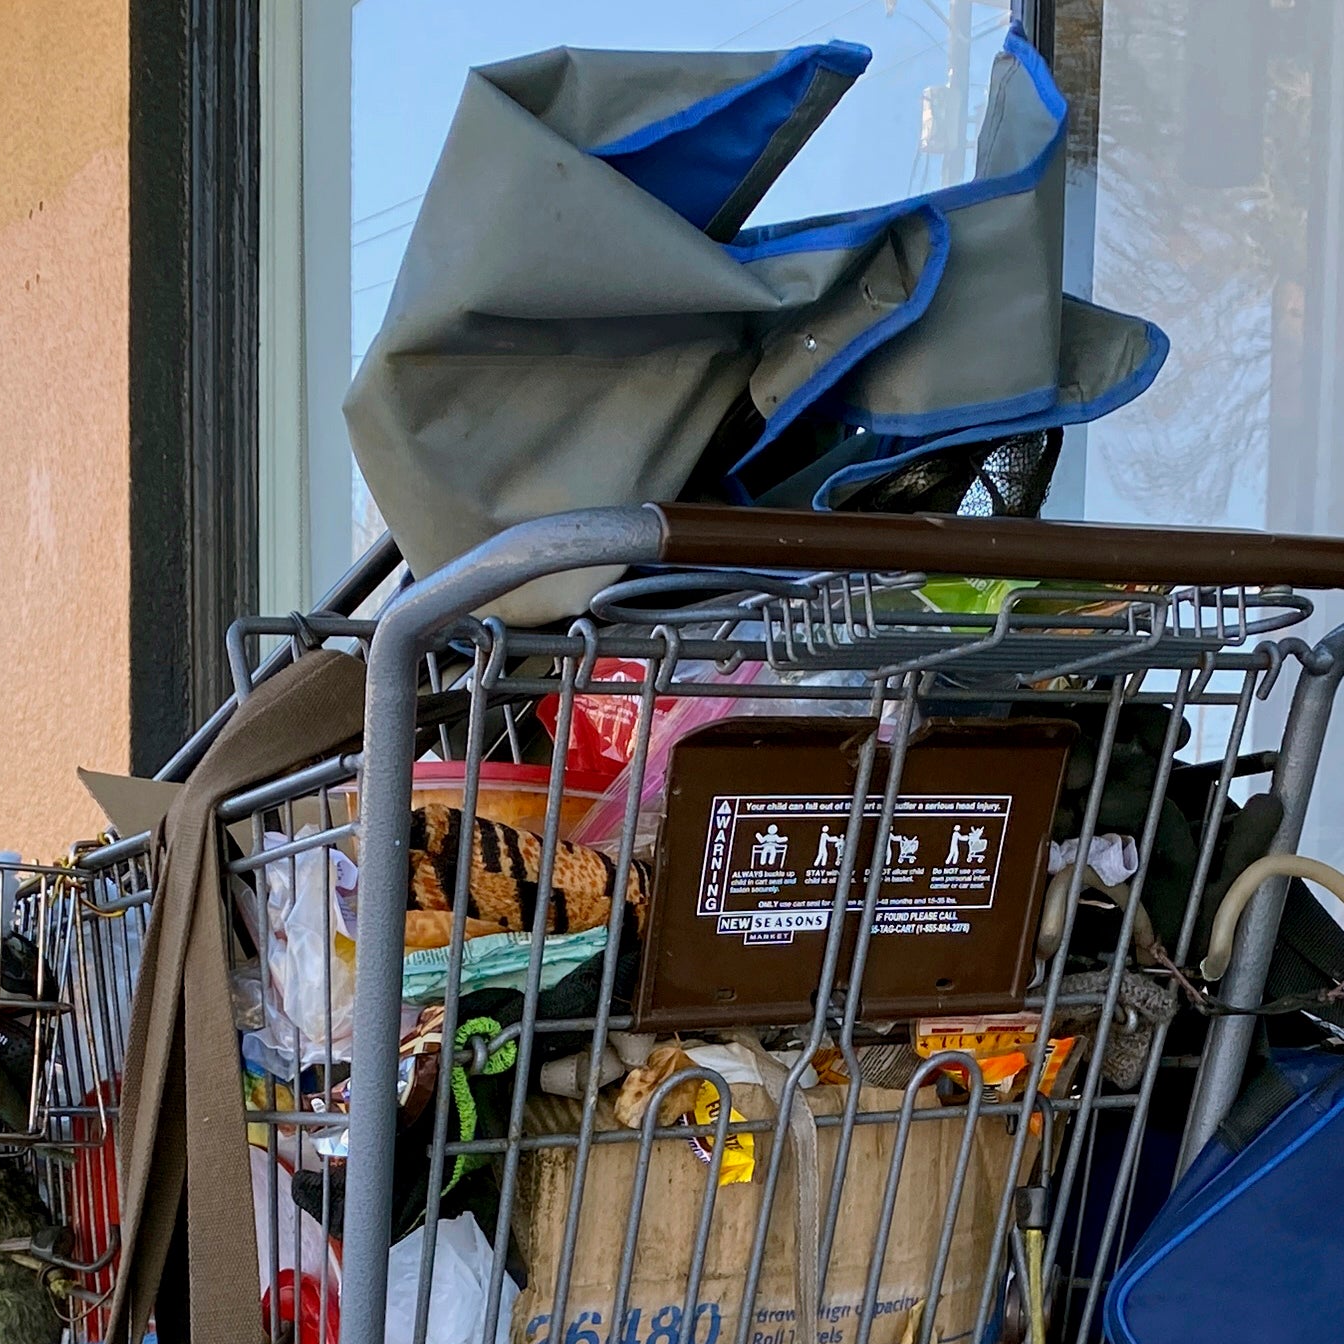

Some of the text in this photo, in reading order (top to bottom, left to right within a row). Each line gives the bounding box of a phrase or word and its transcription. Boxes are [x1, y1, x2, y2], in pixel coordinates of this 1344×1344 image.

[746, 802, 766, 811] Your
[767, 802, 787, 811] child
[788, 803, 804, 811] can
[805, 802, 818, 811] fall
[819, 802, 833, 811] out
[834, 802, 843, 811] of
[924, 802, 955, 810] serious
[956, 802, 975, 810] head
[705, 815, 732, 911] WARNING
[731, 871, 764, 879] ALWAYS
[805, 869, 826, 877] STAY
[883, 912, 909, 921] FOUND
[910, 912, 938, 921] PLEASE
[939, 911, 958, 920] CALL
[720, 915, 823, 930] NEW SEASONS
[749, 932, 790, 941] MARKET
